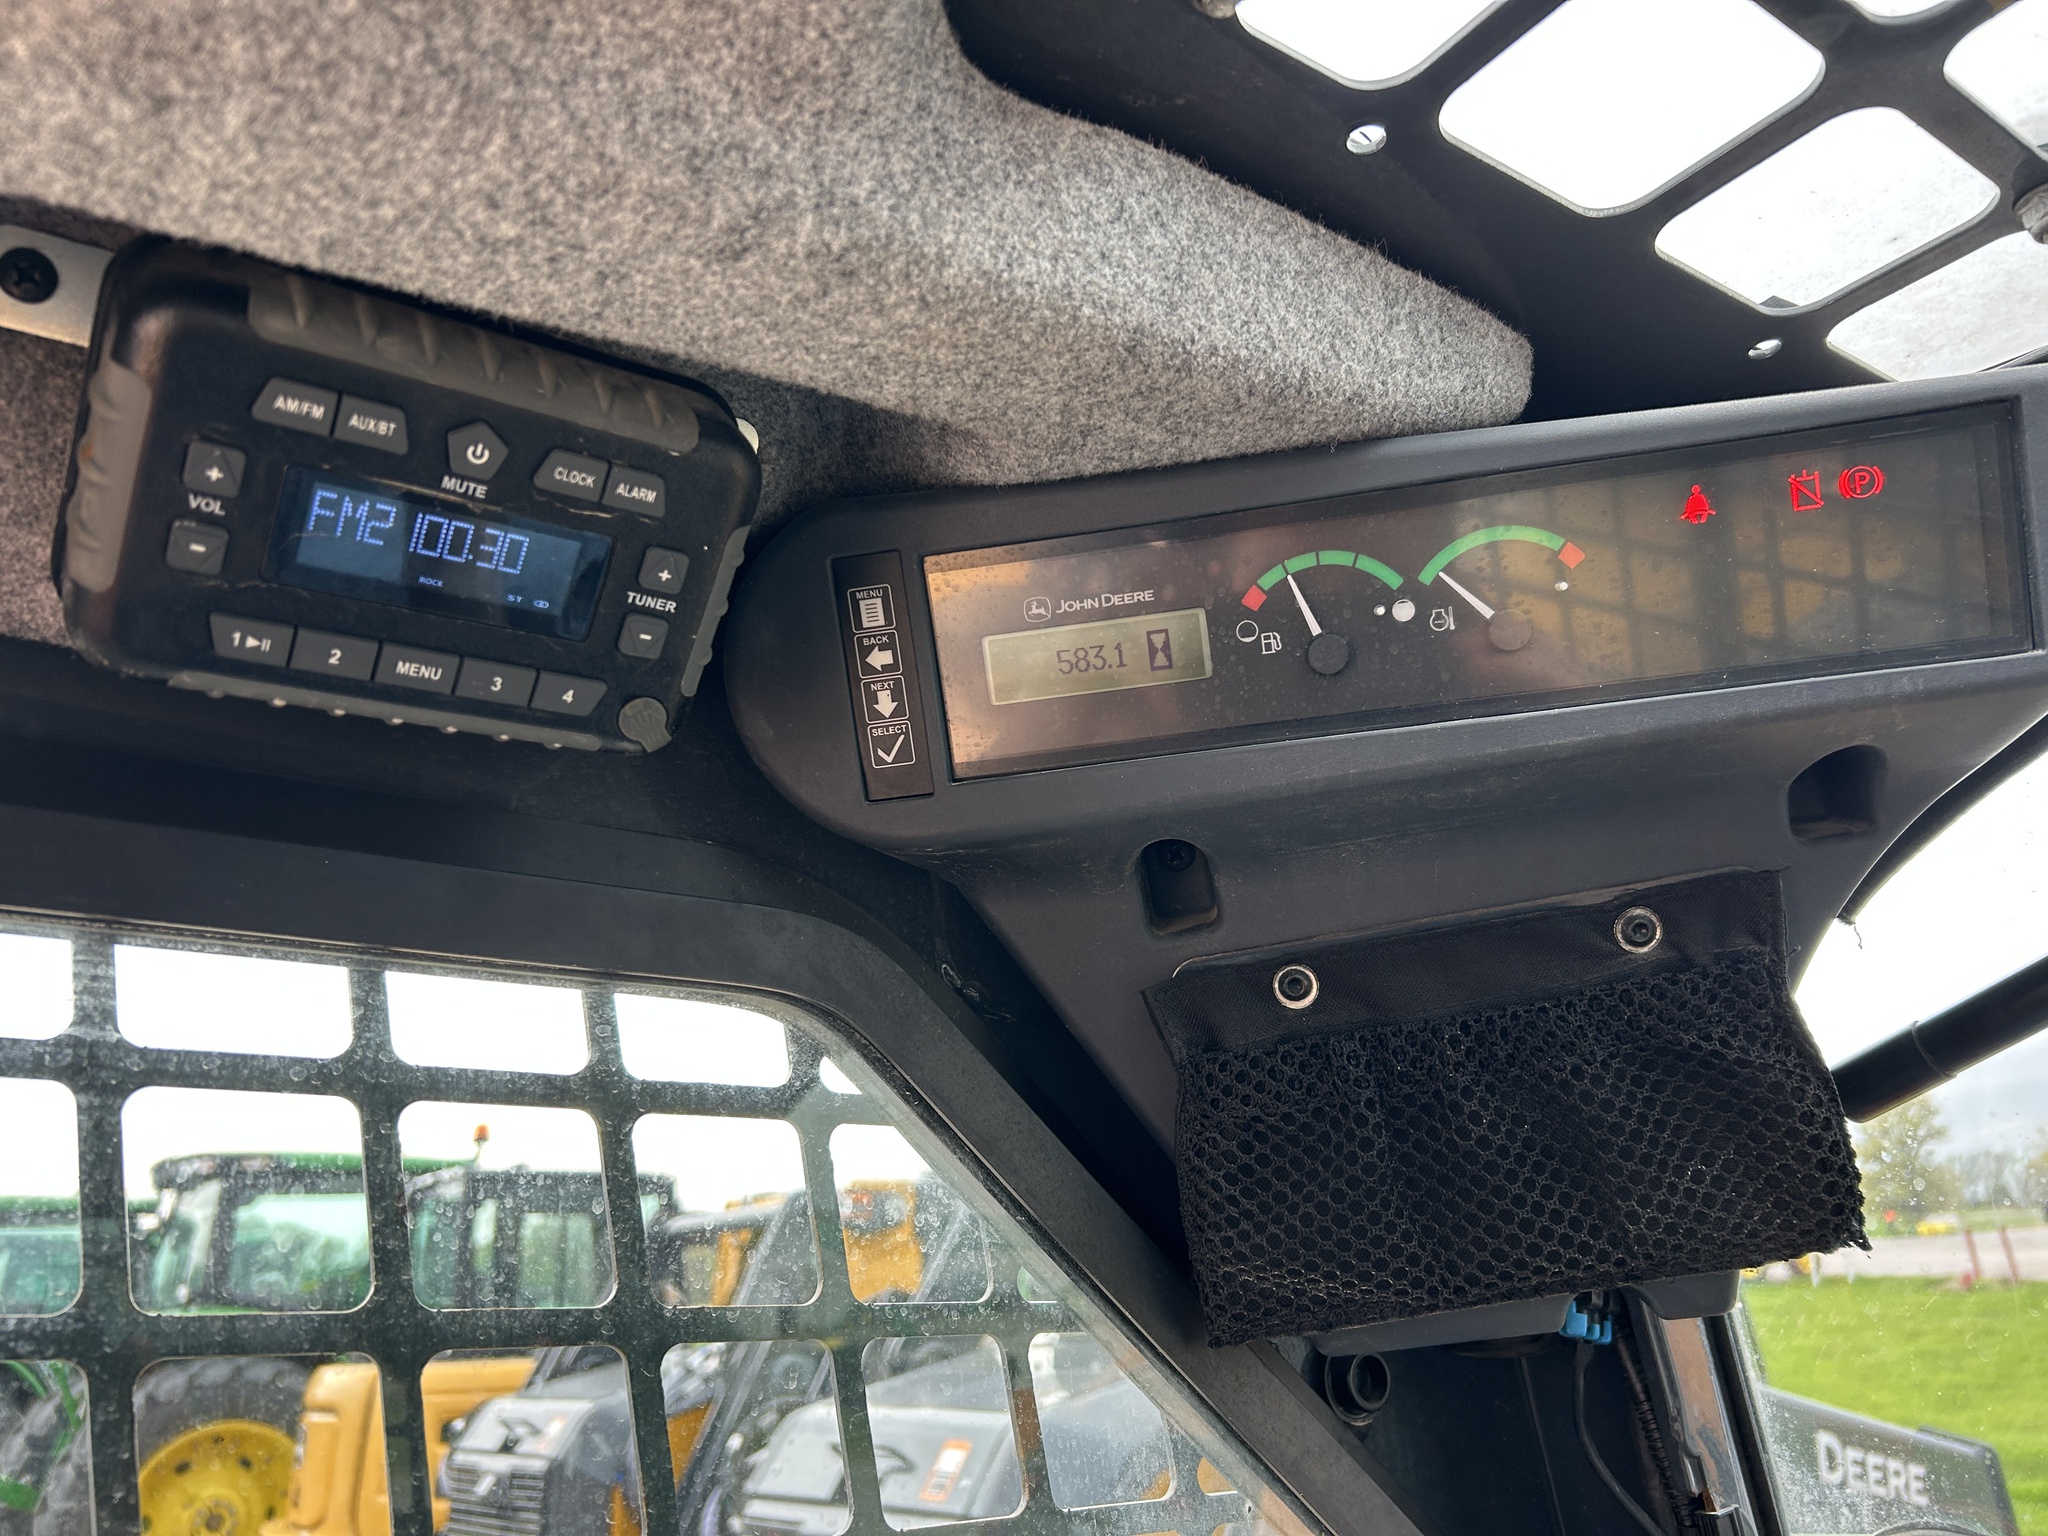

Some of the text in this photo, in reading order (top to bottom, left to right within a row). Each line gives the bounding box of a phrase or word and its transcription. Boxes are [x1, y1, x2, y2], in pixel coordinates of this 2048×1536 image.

[273, 393, 325, 421] AM/FM
[441, 475, 488, 499] MUTE
[553, 466, 596, 488] CLOCK
[615, 482, 657, 503] ALARM
[188, 492, 226, 516] VOL
[307, 489, 530, 575] FM2 100.30
[418, 575, 444, 588] ROCK
[507, 593, 524, 604] ST
[627, 591, 677, 614] TUNER
[856, 588, 883, 600] MENU
[1055, 589, 1155, 614] JOHN DEERE
[231, 632, 241, 647] 1
[863, 635, 889, 646] BACK
[328, 649, 342, 665] 2
[1055, 642, 1127, 676] 583.1
[395, 661, 443, 681] MENU
[490, 677, 503, 692] 3
[870, 680, 895, 692] NEXT
[562, 689, 575, 704] 4
[871, 724, 907, 737] SELECT
[1815, 1429, 1930, 1507] DEERE
